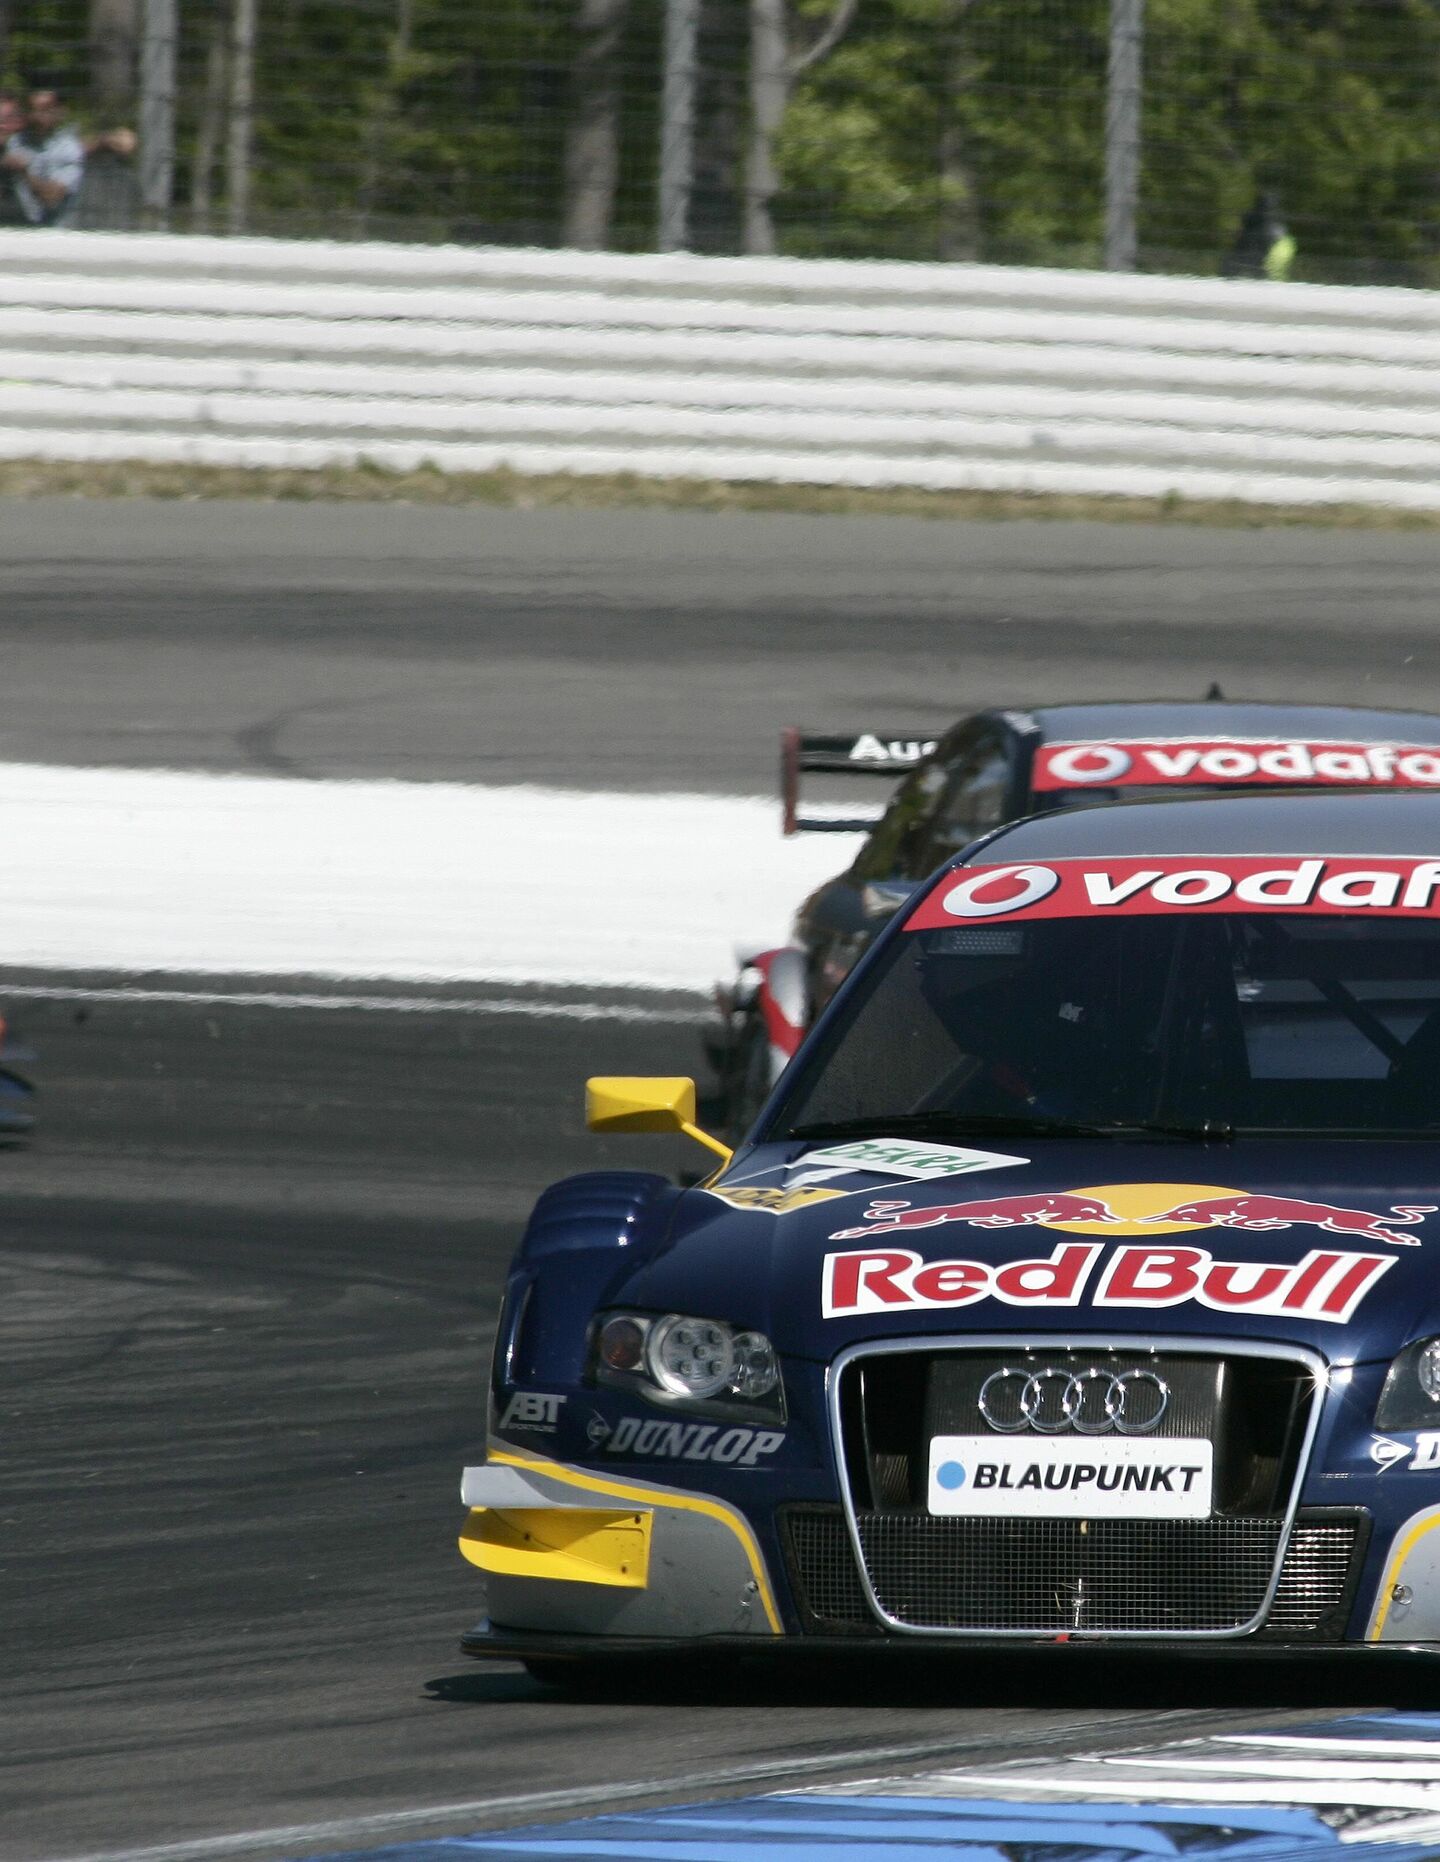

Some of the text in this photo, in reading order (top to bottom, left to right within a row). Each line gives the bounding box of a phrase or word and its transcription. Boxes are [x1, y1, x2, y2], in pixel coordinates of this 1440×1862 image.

[813, 1142, 989, 1174] DEKRA
[826, 1243, 1395, 1320] Red Bull
[498, 1391, 569, 1430] ABT
[608, 1417, 786, 1465] DUNLOP
[972, 1461, 1204, 1494] BLAUPUNKT
